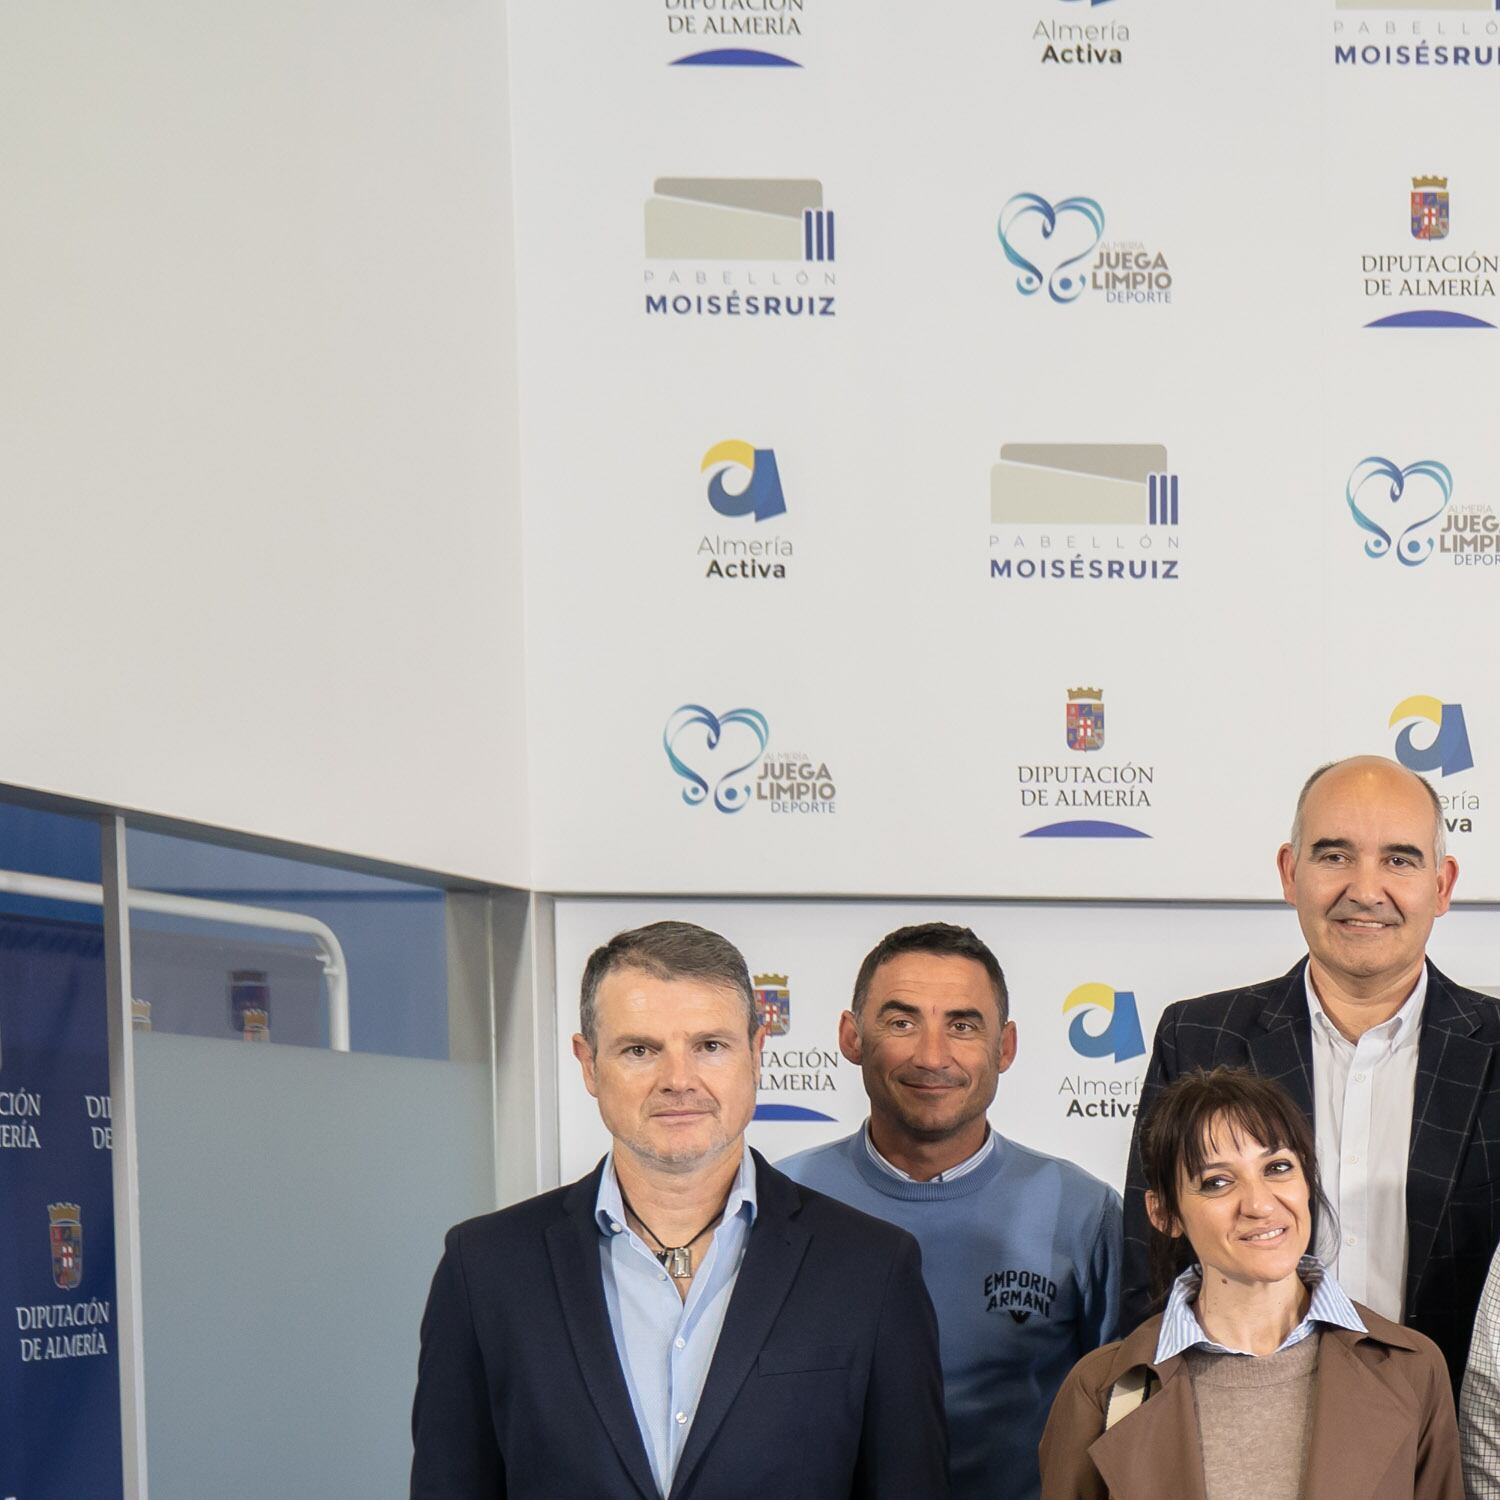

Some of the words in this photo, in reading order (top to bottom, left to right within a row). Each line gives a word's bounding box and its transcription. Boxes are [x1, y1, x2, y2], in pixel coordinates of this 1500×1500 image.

[667, 15, 696, 34] DE
[703, 14, 802, 35] ALMERÍA
[1033, 20, 1129, 44] Almería
[1042, 44, 1122, 64] Activa
[1088, 251, 1168, 271] JUEGA
[1362, 253, 1498, 276] DIPUTACIÓN
[644, 270, 836, 285] PABELLÓN
[1092, 271, 1172, 292] LIMPIO
[1365, 279, 1392, 296] DE
[1400, 275, 1495, 296] ALMERÍA
[646, 290, 835, 316] MOISÉSRUIZ
[1106, 291, 1170, 303] DEPORTE
[697, 536, 793, 559] Almería
[989, 534, 1178, 549] PABELLÓN
[706, 559, 785, 578] Activa
[991, 554, 1178, 579] MOISÉSRUIZ
[754, 762, 832, 783] JUEGA
[1018, 762, 1153, 783] DIPUTACIÓN
[757, 782, 836, 802] LIMPIO
[1021, 790, 1048, 806] DE
[1055, 786, 1151, 806] ALMERÍA
[1439, 791, 1480, 810] ería
[771, 800, 835, 813] DEPORTE
[760, 1047, 839, 1068] TACIÓN
[759, 1070, 836, 1091] LMERÍA
[1058, 1076, 1139, 1095] Almerí
[984, 1270, 1057, 1300] EMPORIO
[16, 1297, 109, 1330] DIPUTACIÓN
[986, 1290, 1050, 1318] ARMANI
[21, 1338, 42, 1361] DE
[45, 1327, 107, 1359] ALMERÍA
